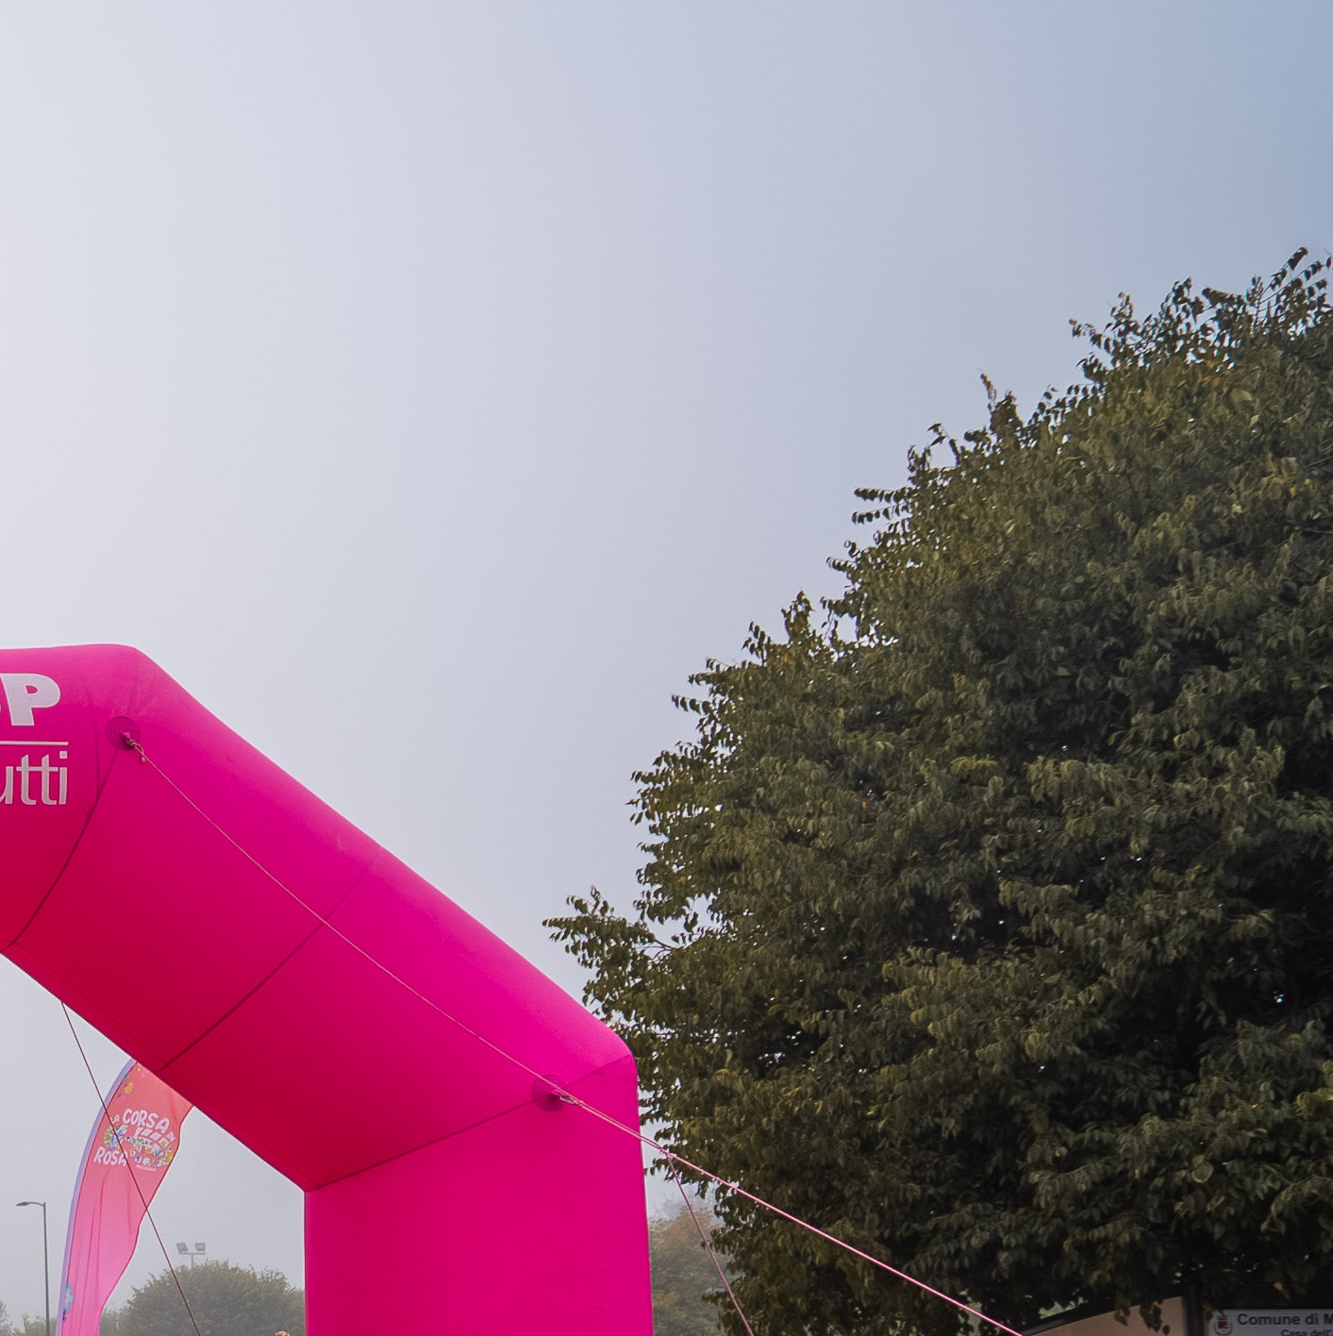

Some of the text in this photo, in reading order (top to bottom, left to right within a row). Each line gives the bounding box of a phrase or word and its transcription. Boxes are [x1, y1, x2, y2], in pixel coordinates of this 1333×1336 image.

[122, 1108, 170, 1134] CORSA
[93, 1146, 128, 1167] ROSA
[1237, 1313, 1301, 1326] Comune
[1305, 1313, 1319, 1325] di
